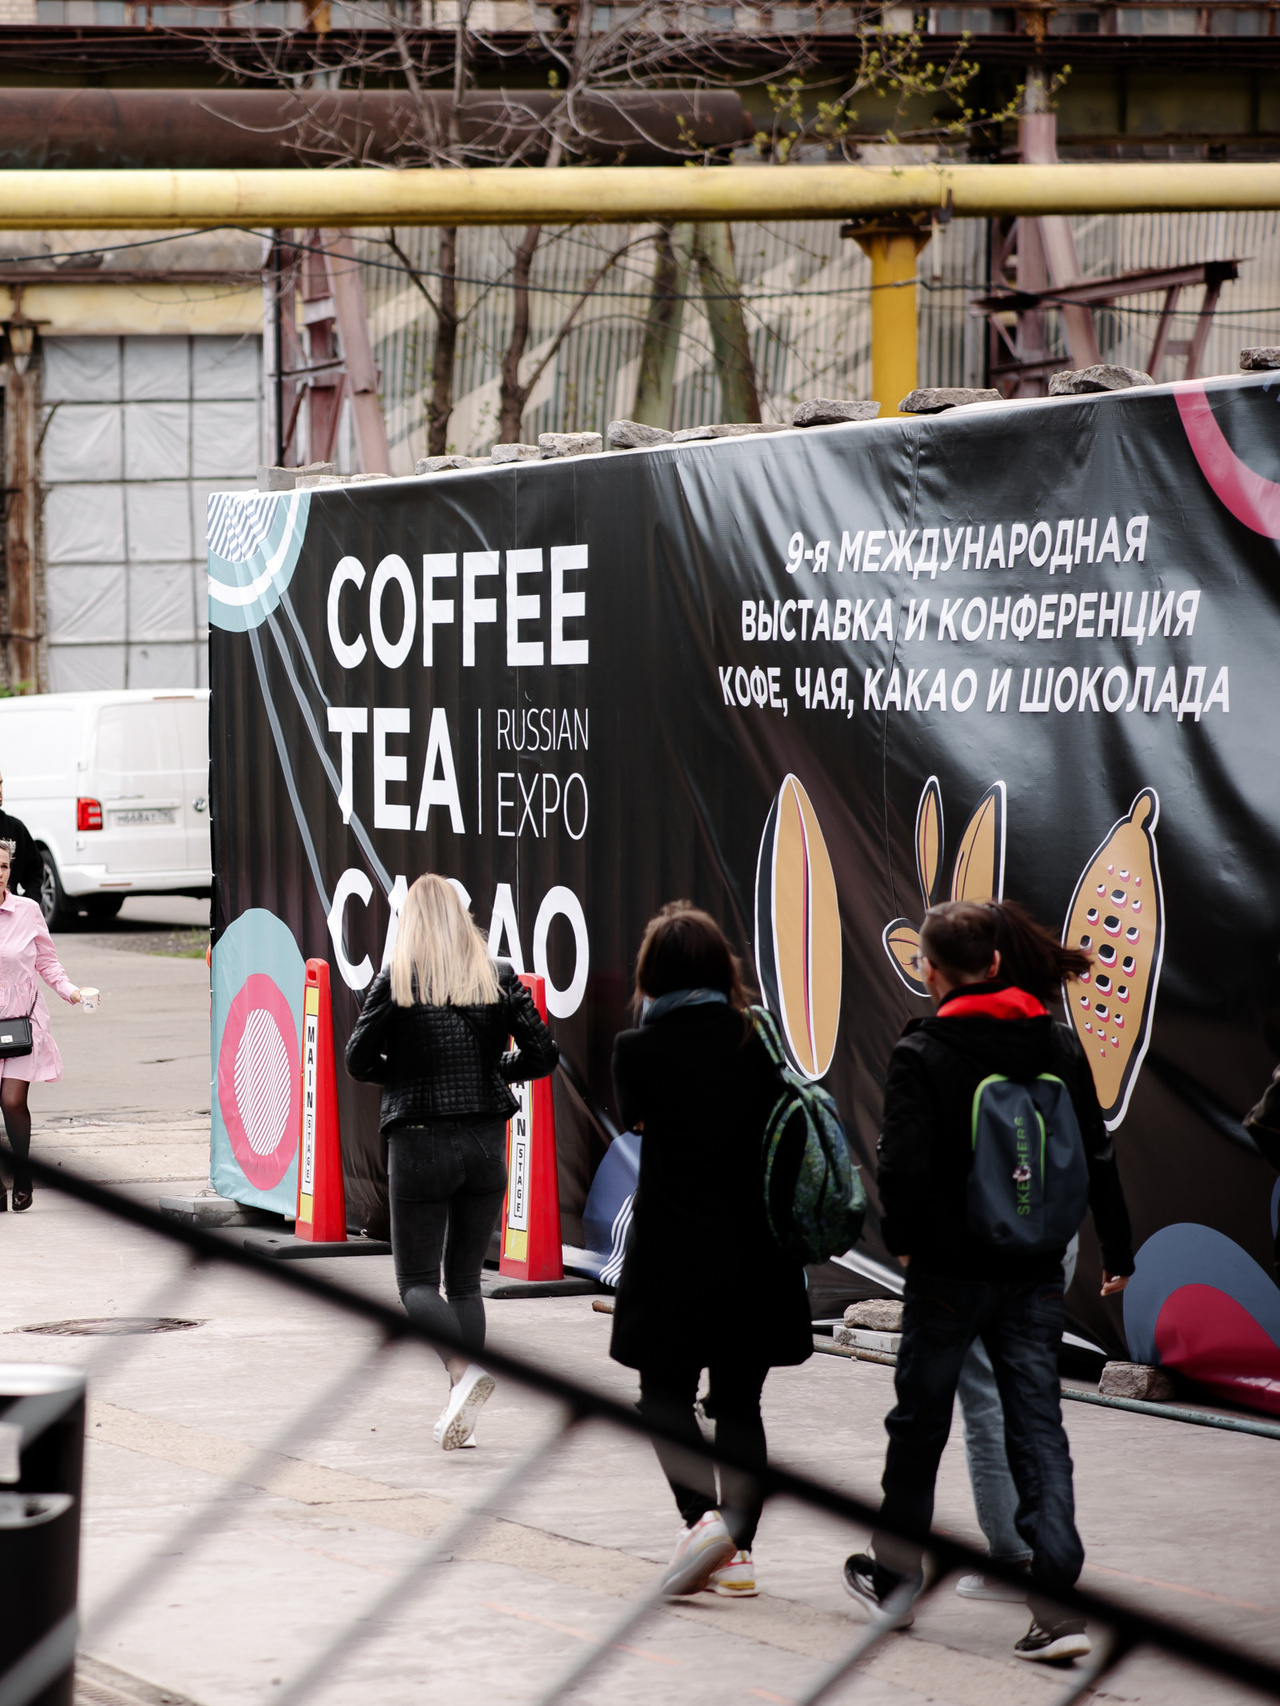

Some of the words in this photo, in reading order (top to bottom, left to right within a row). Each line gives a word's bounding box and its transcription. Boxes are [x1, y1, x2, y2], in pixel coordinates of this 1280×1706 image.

[786, 531, 830, 574] 9-я
[837, 515, 1149, 580] МЕЖДУНАРОДНАЯ
[327, 544, 589, 669] COFFEE
[741, 599, 894, 641] ВЫСТАВКА
[905, 600, 929, 641] И
[937, 589, 1202, 645] КОНФЕРЕНЦИЯ
[718, 665, 789, 716] КОФЕ,
[795, 667, 855, 719] ЧАЯ,
[863, 666, 979, 713] КАКАО
[986, 666, 1013, 713] И
[1019, 665, 1231, 722] ШОКОЛАДА
[497, 708, 590, 751] RUSSIAN
[327, 707, 466, 835] TEA
[497, 772, 589, 840] EXPO
[306, 1026, 316, 1109] MAIN
[1013, 1116, 1031, 1216] SKEHERS
